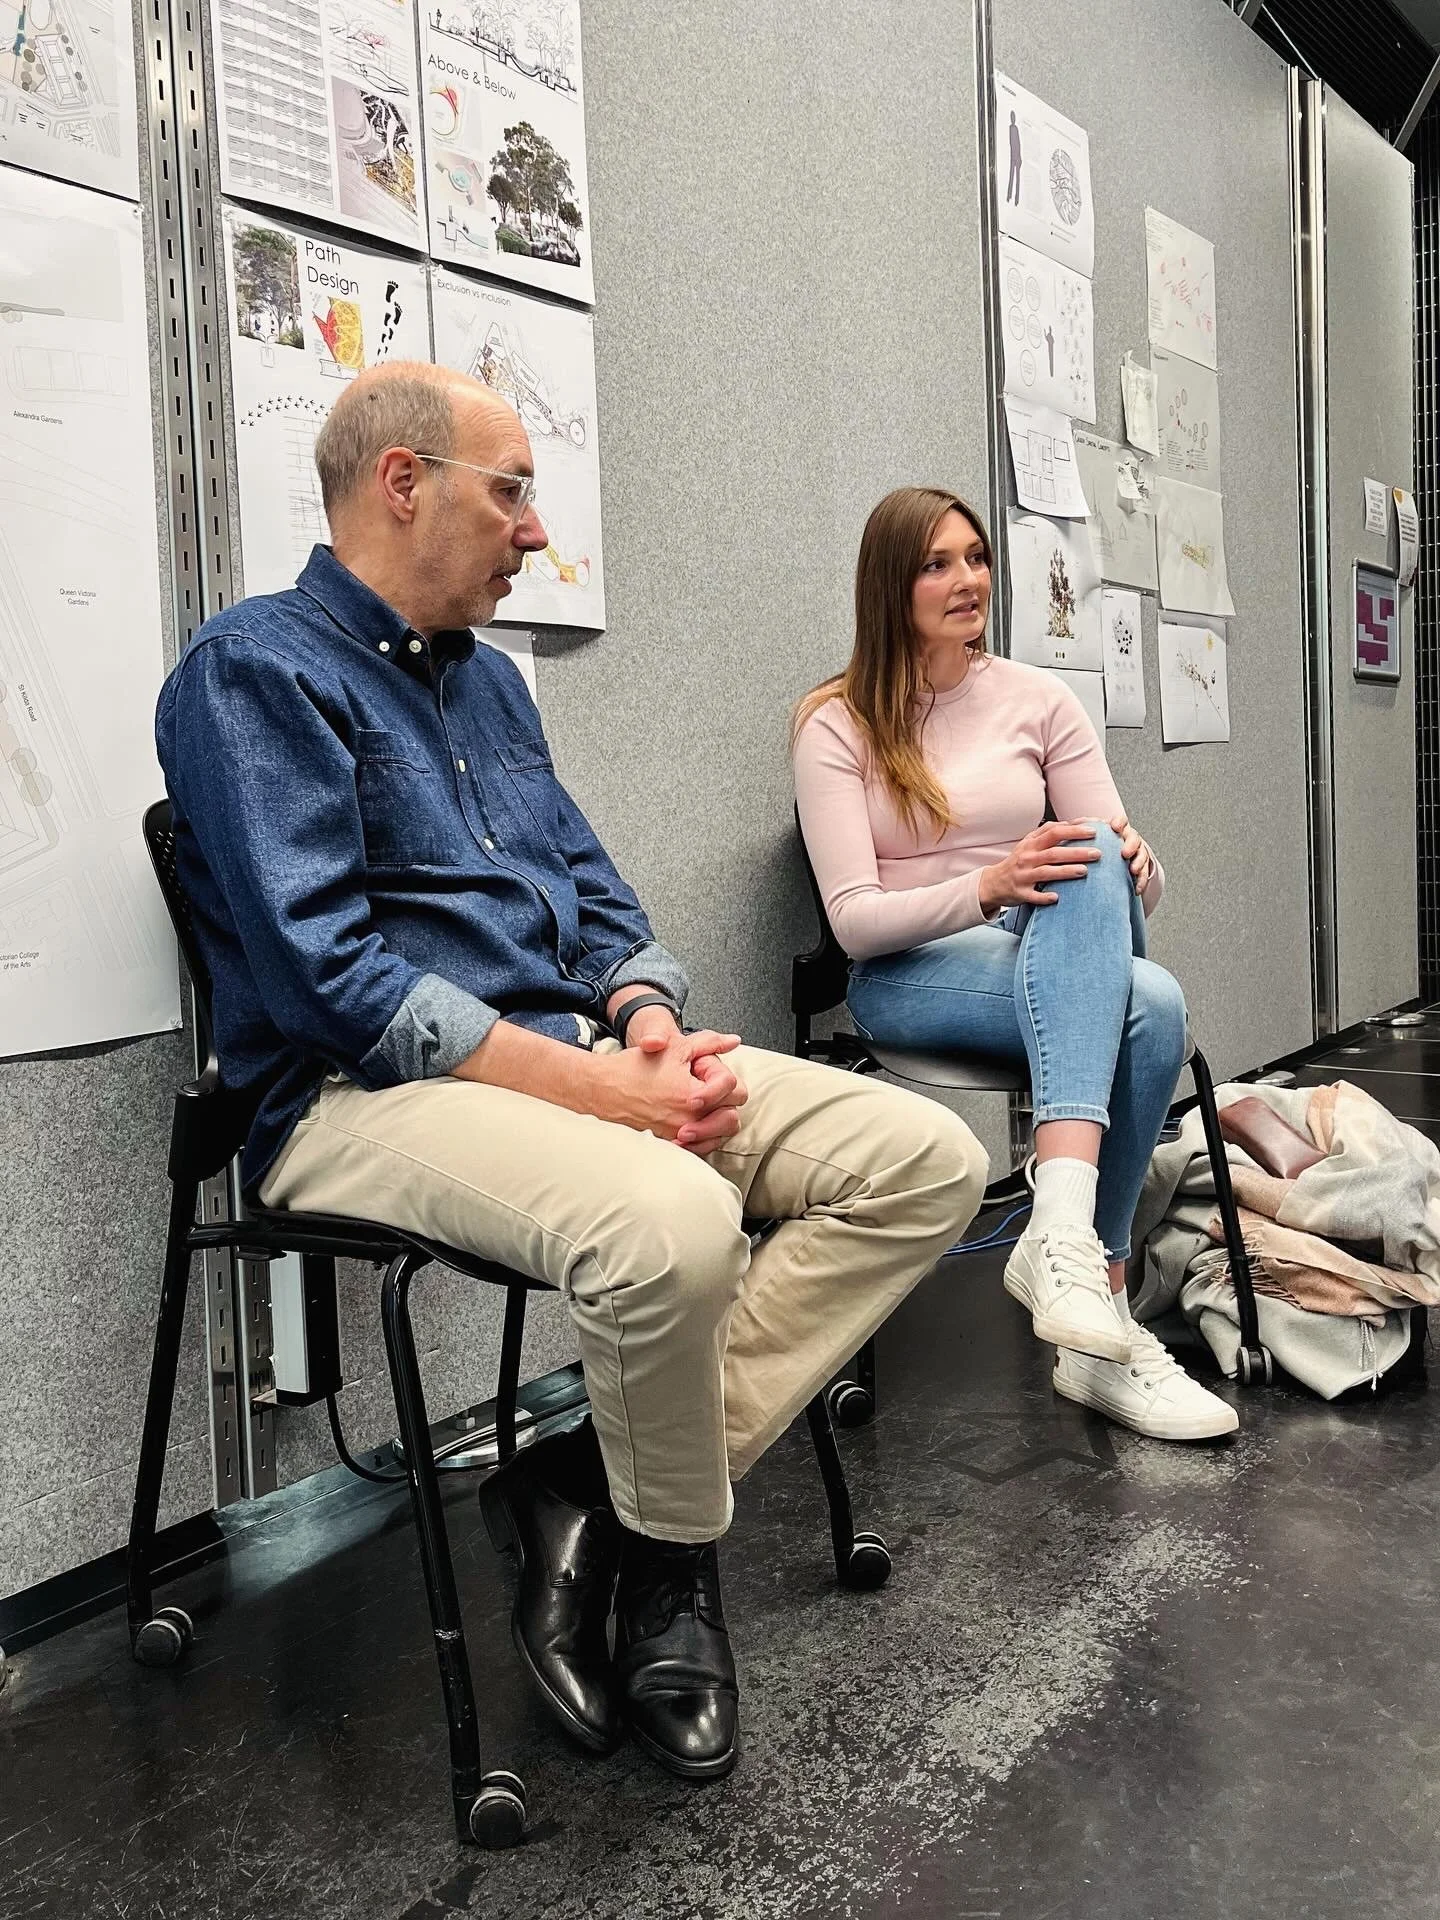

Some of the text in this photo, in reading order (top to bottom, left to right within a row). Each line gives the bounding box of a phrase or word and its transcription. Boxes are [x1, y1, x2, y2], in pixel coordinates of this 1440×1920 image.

[427, 53, 517, 101] Above & Below
[305, 240, 341, 265] Path
[307, 265, 360, 295] Design
[437, 279, 512, 307] Exclusion vs inclusion
[27, 706, 37, 722] Road
